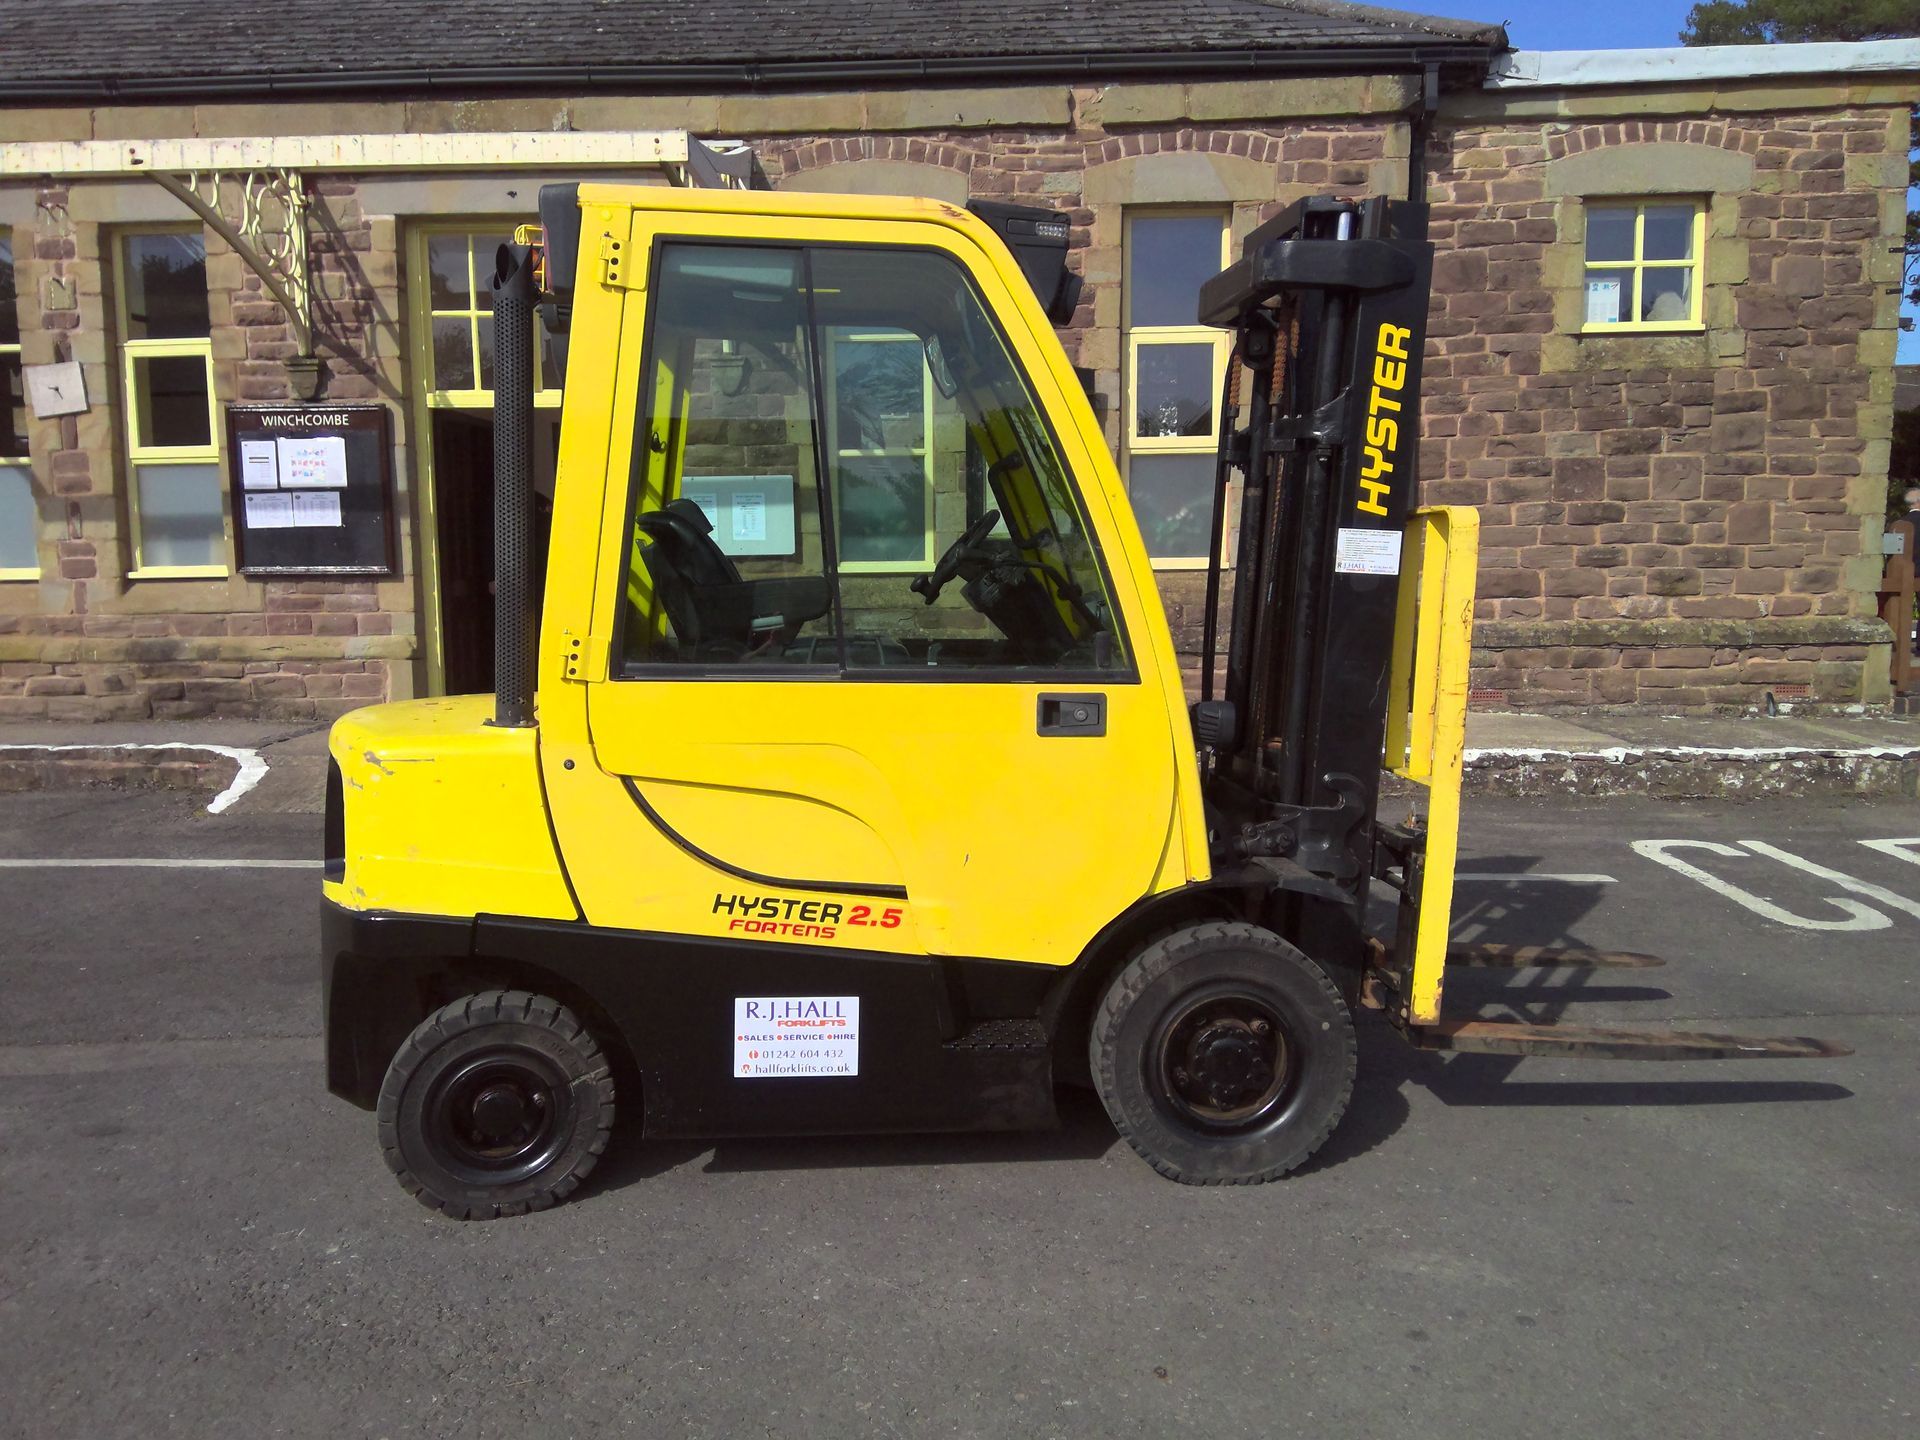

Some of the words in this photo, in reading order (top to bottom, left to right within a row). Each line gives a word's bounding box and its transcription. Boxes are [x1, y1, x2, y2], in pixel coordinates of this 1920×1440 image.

[261, 414, 350, 427] WINCHCOMBE
[1356, 322, 1411, 517] HYSTER
[711, 893, 844, 924] HYSTER
[847, 905, 904, 929] 2.5
[729, 919, 837, 939] FORTENS
[777, 1019, 847, 1028] FORKLIFTS
[744, 1034, 775, 1042] SALES
[783, 1033, 825, 1042] SERVICE
[833, 1033, 857, 1041] HIRE
[762, 1050, 796, 1059] 01242
[800, 1049, 820, 1059] 604
[824, 1048, 844, 1059] 432
[755, 1062, 850, 1075] hallforklifts.co.uk
